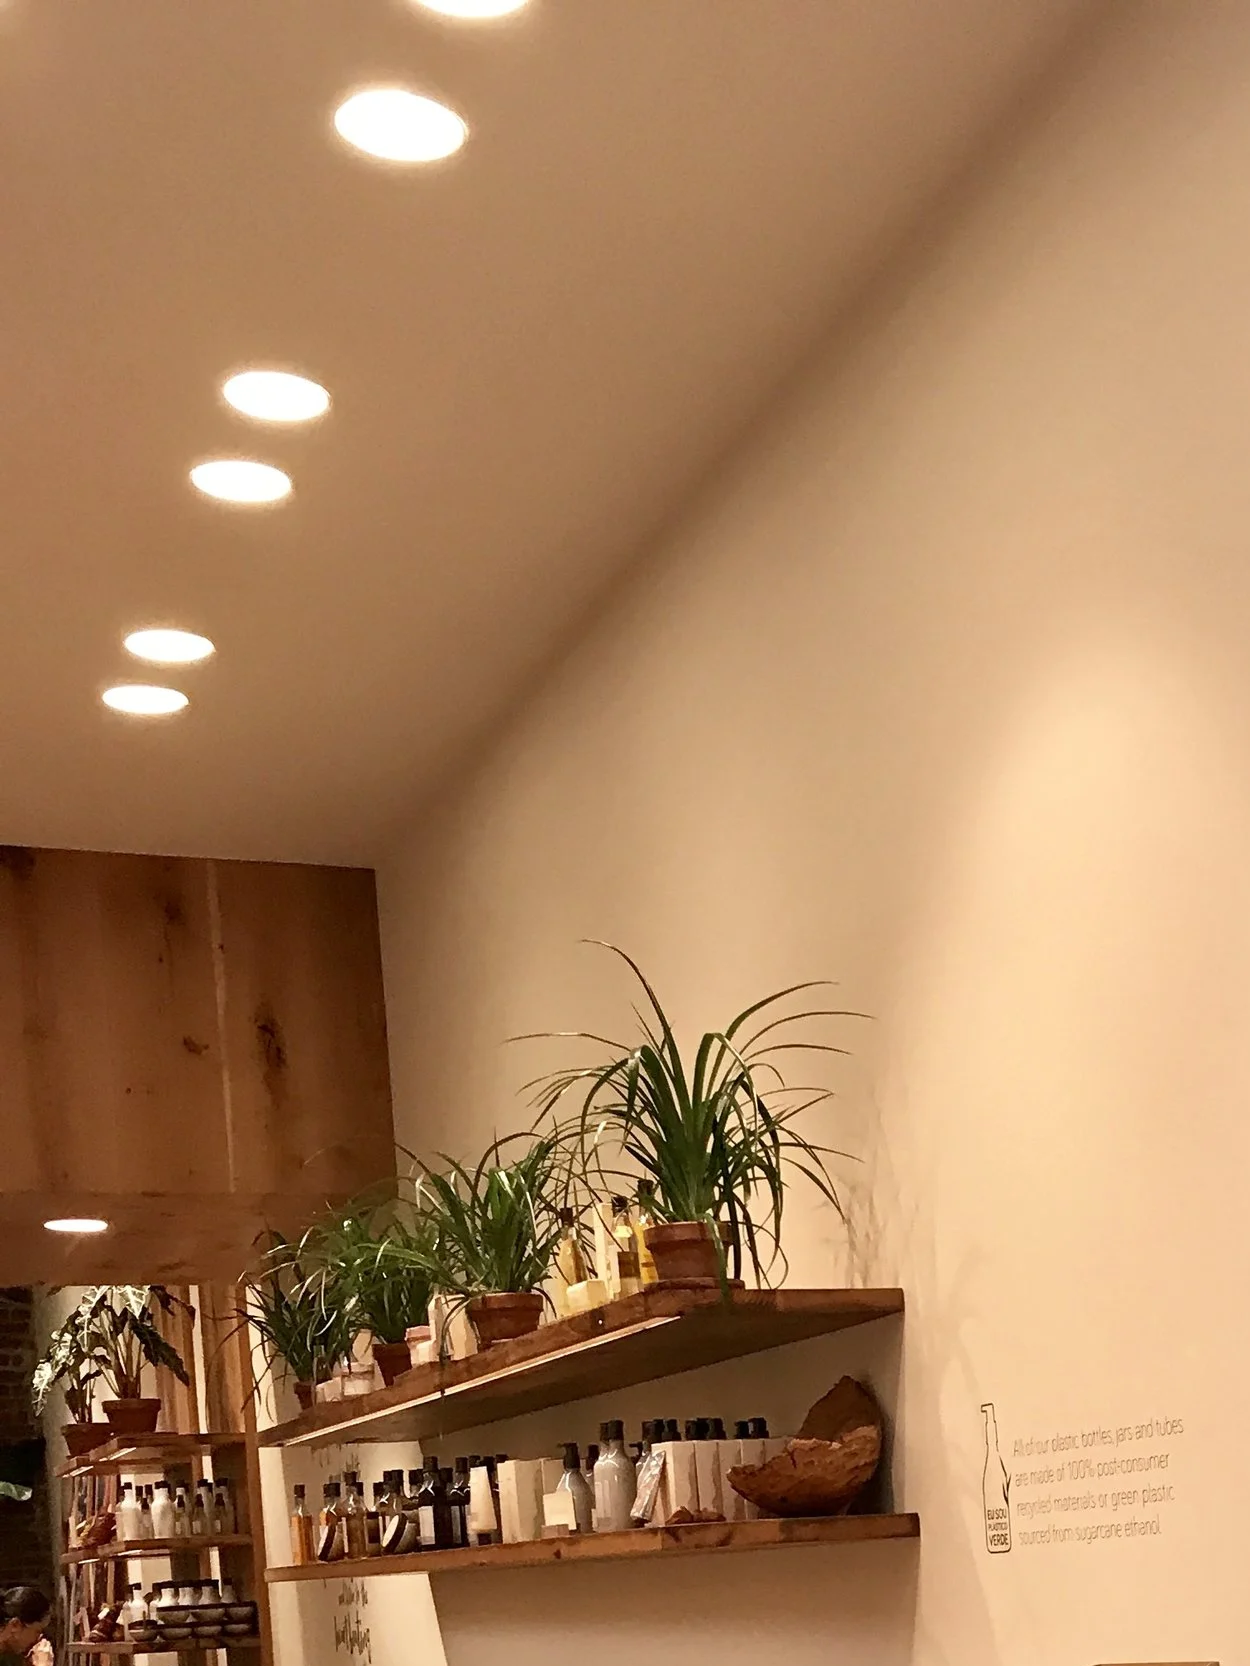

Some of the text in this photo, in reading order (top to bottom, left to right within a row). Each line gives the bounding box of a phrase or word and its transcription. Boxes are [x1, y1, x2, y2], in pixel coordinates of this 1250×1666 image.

[1135, 1418, 1154, 1440] and
[1155, 1415, 1185, 1437] tubes
[1030, 1465, 1055, 1486] made
[1056, 1462, 1066, 1482] of
[1067, 1456, 1096, 1481] 100%
[1098, 1492, 1109, 1508] or
[1111, 1488, 1140, 1512] green
[1142, 1482, 1176, 1509] plastic
[989, 1533, 1009, 1546] VERDE
[1075, 1521, 1123, 1545] sugarcane
